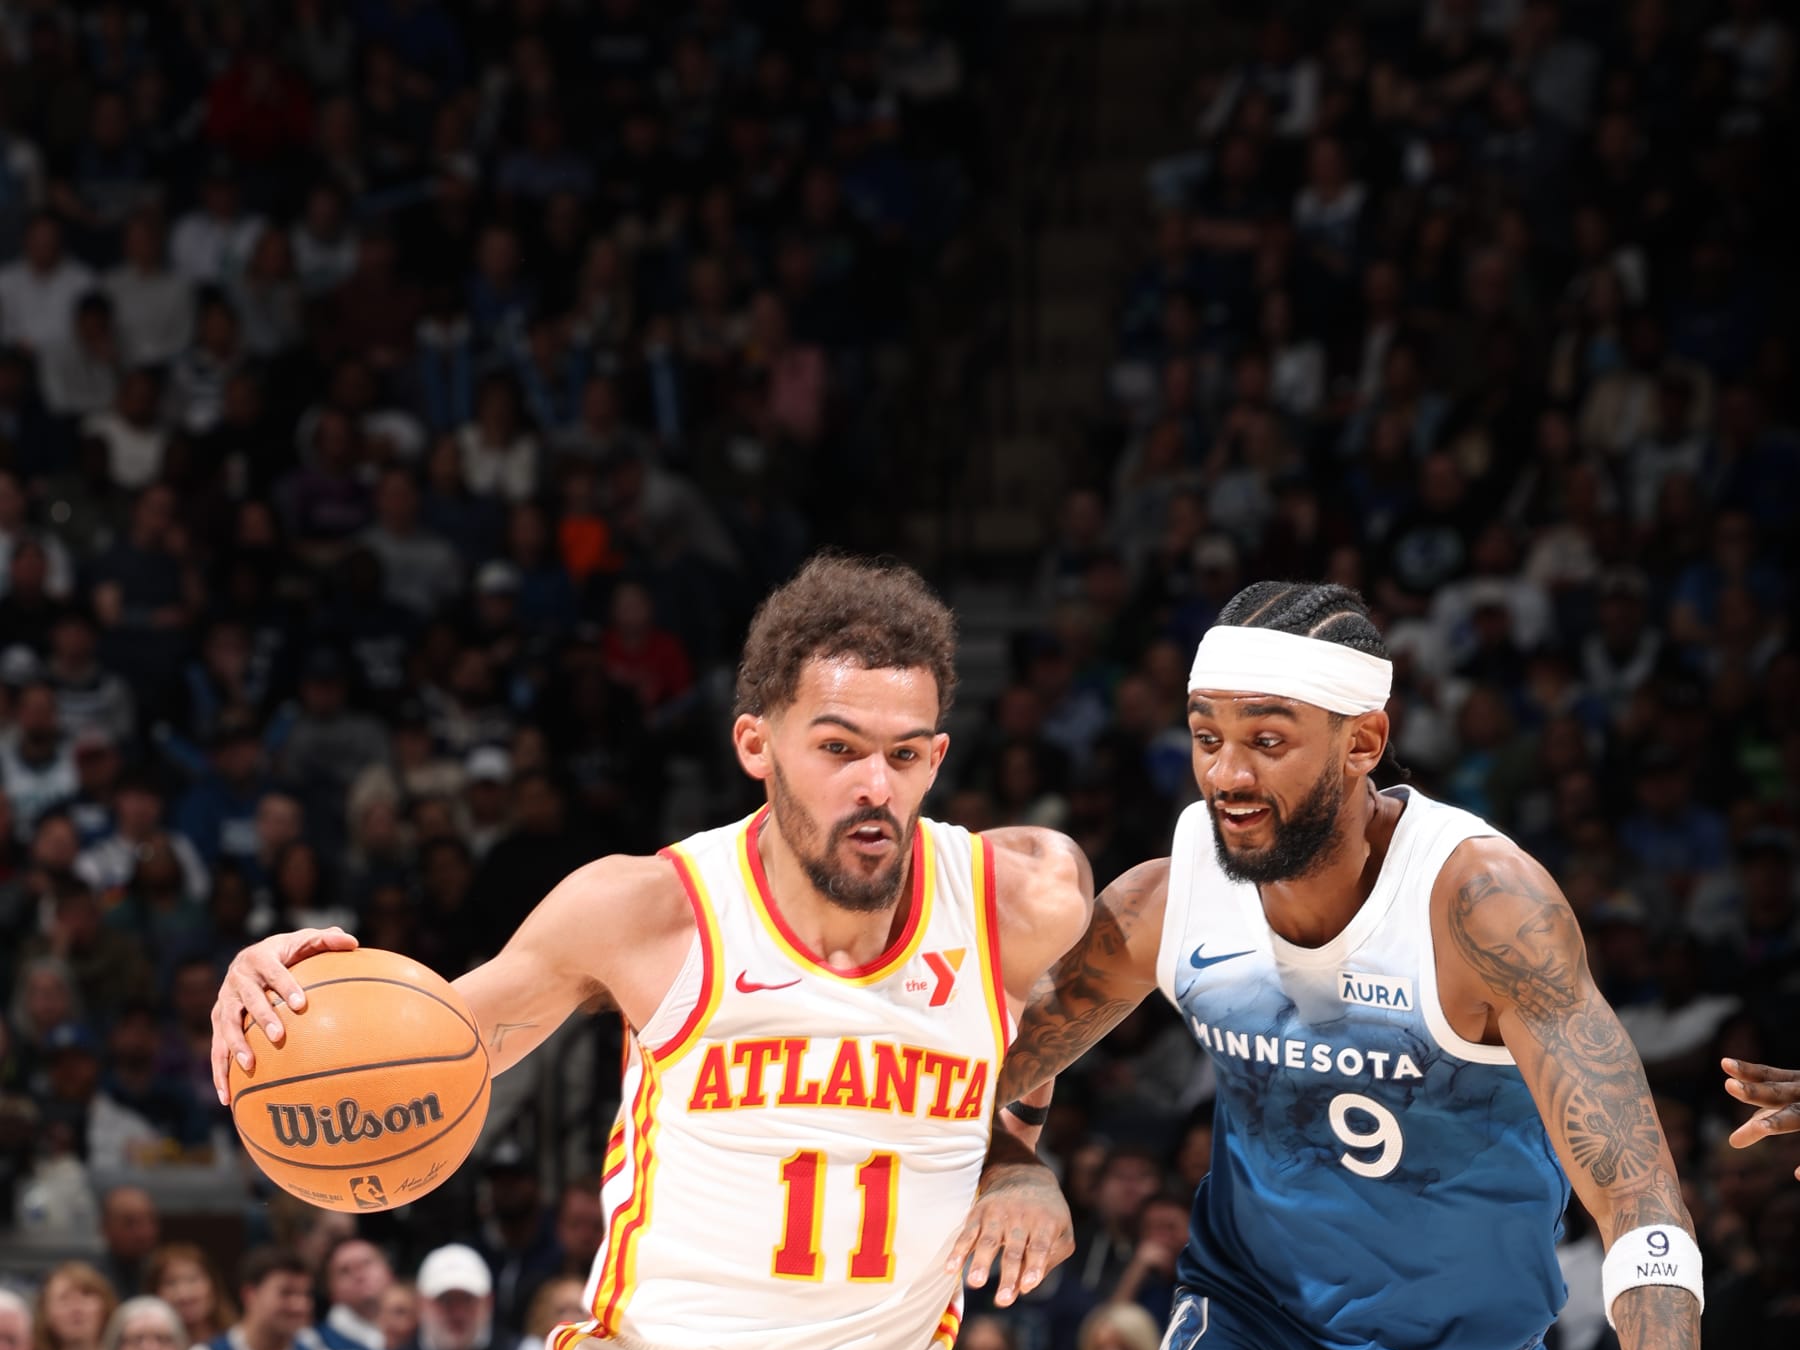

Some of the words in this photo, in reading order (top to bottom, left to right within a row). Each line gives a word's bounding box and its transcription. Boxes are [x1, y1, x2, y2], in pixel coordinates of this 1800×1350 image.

[905, 980, 928, 992] the
[1191, 1015, 1424, 1080] MINNESOTA
[687, 1036, 989, 1120] ATLANTA
[266, 1092, 443, 1147] Wilson
[1328, 1093, 1404, 1179] 9
[771, 1148, 901, 1284] 11
[1646, 1230, 1670, 1258] 9
[1636, 1262, 1678, 1279] NAW
